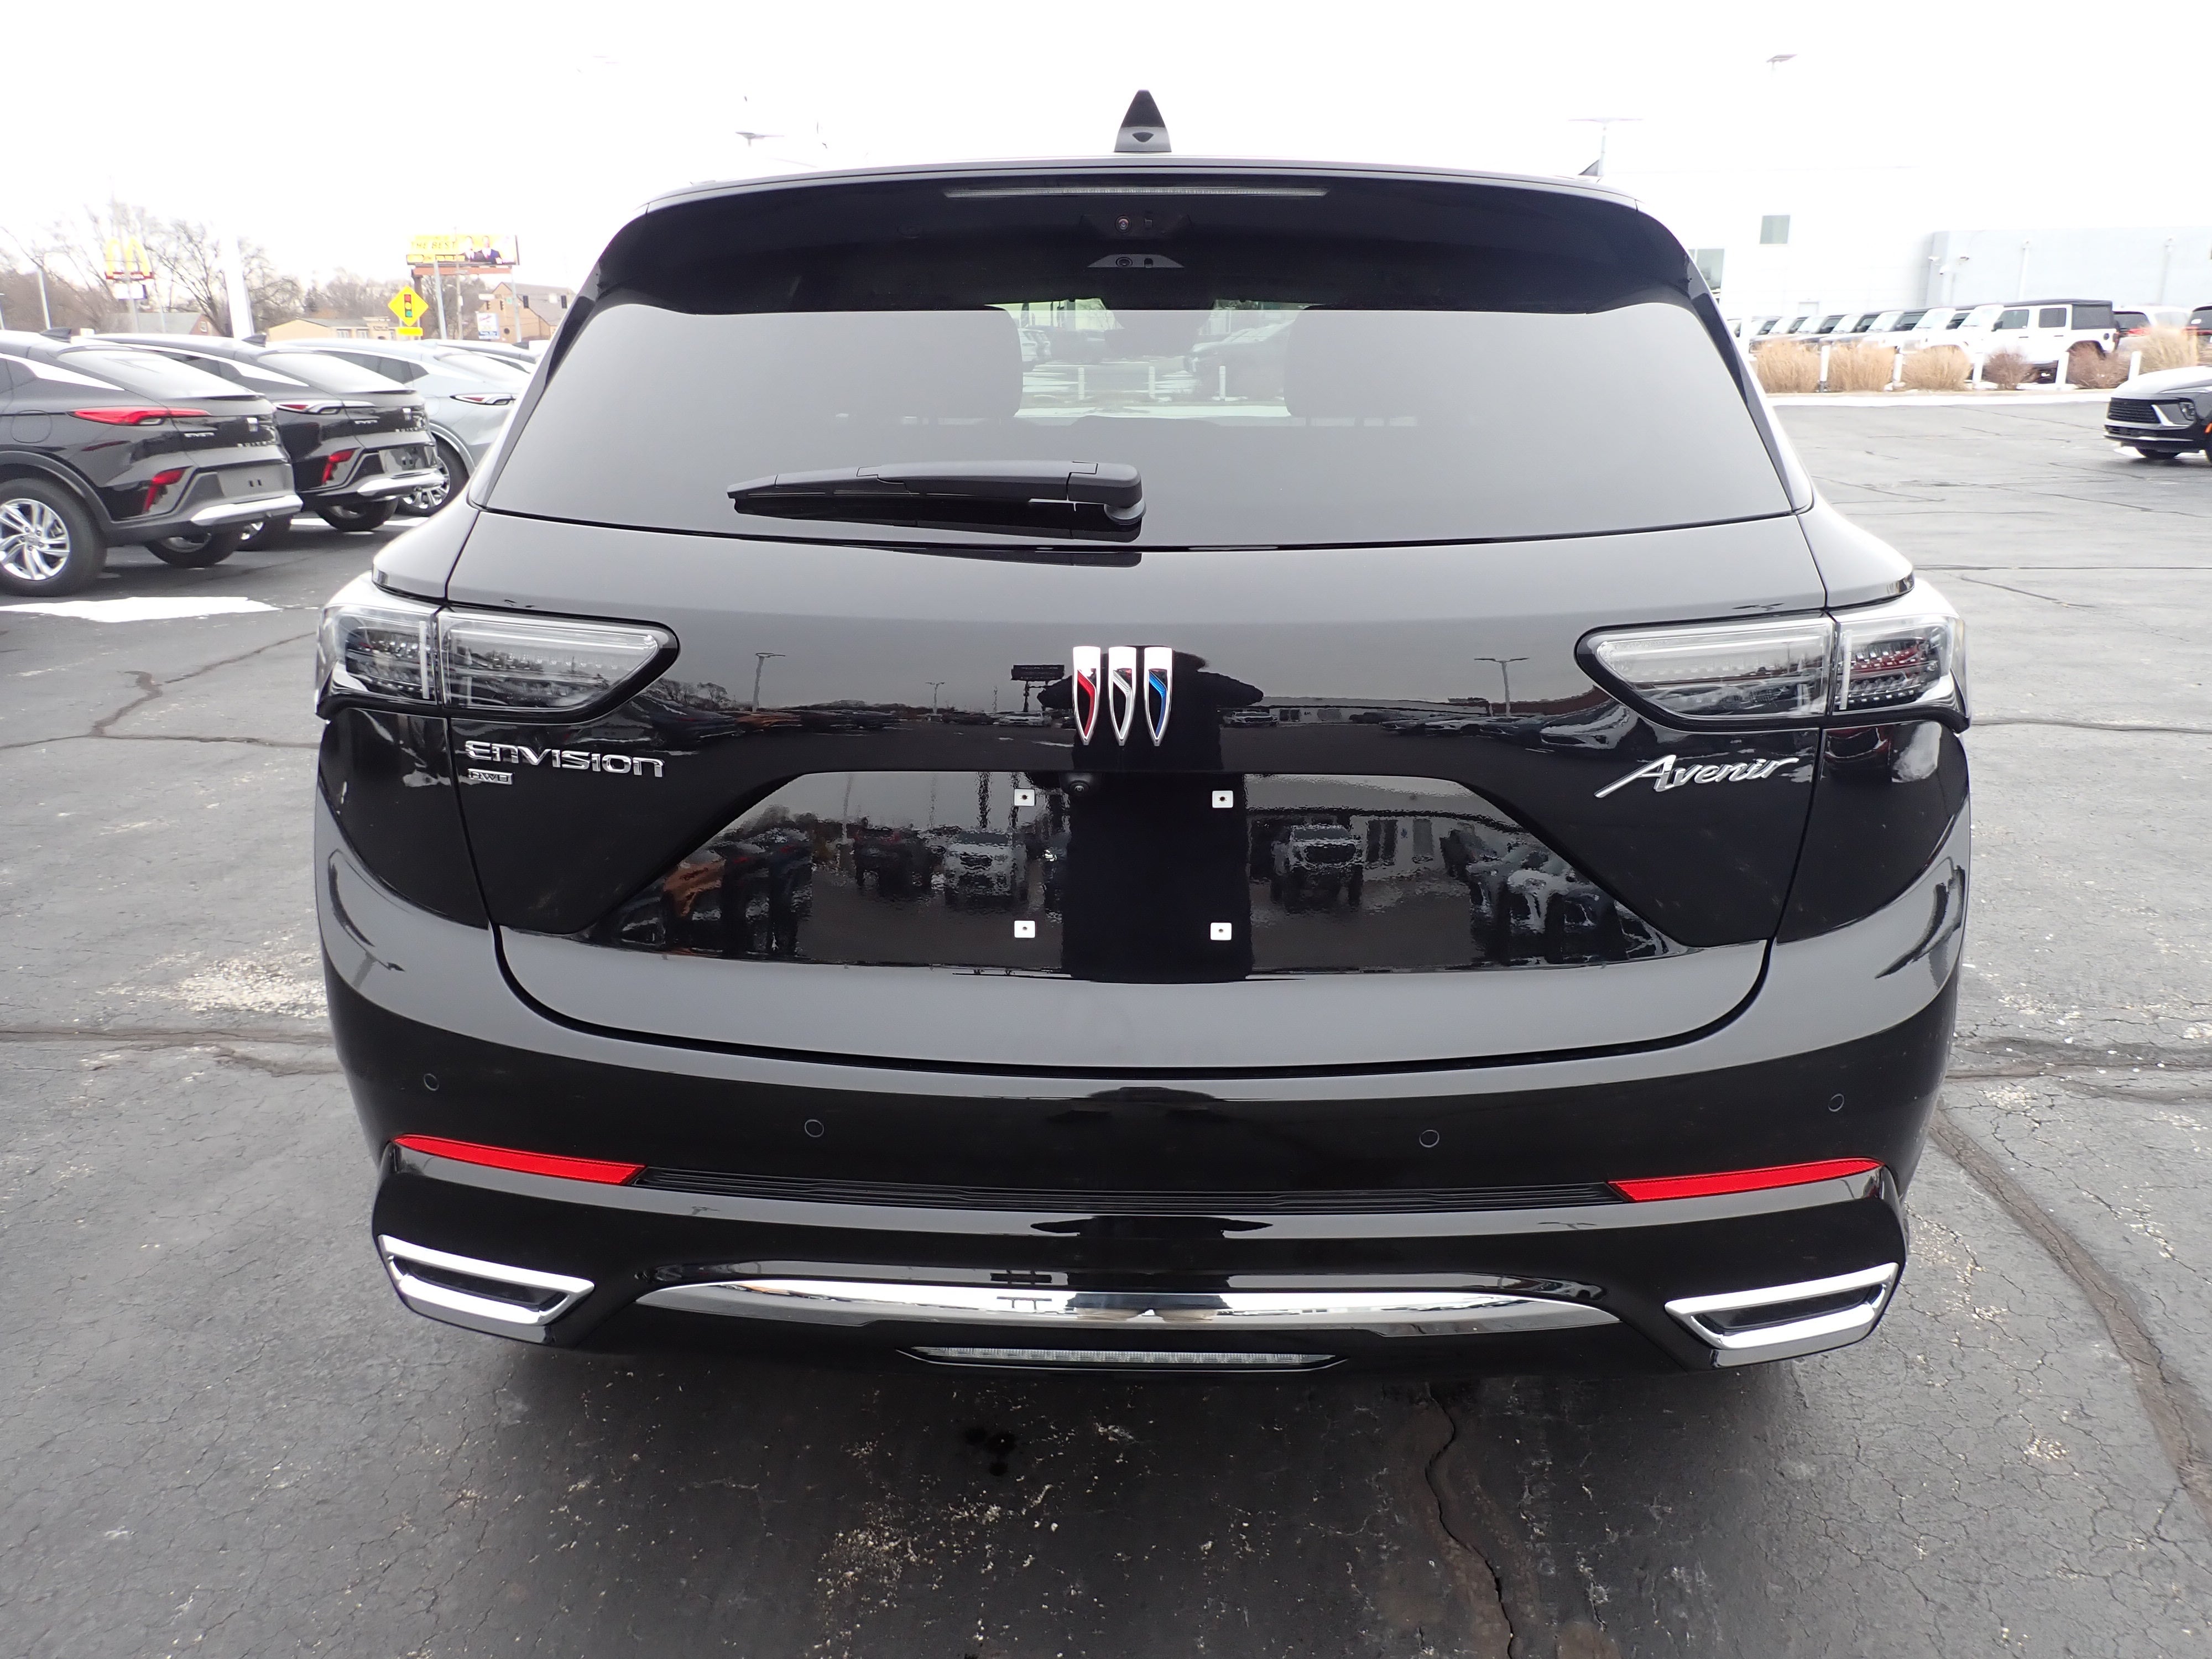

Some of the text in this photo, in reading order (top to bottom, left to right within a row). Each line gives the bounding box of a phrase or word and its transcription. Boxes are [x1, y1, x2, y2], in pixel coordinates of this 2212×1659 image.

[465, 740, 665, 778] ENVISION
[469, 770, 510, 783] AWD
[1593, 754, 1799, 798] Avenir
